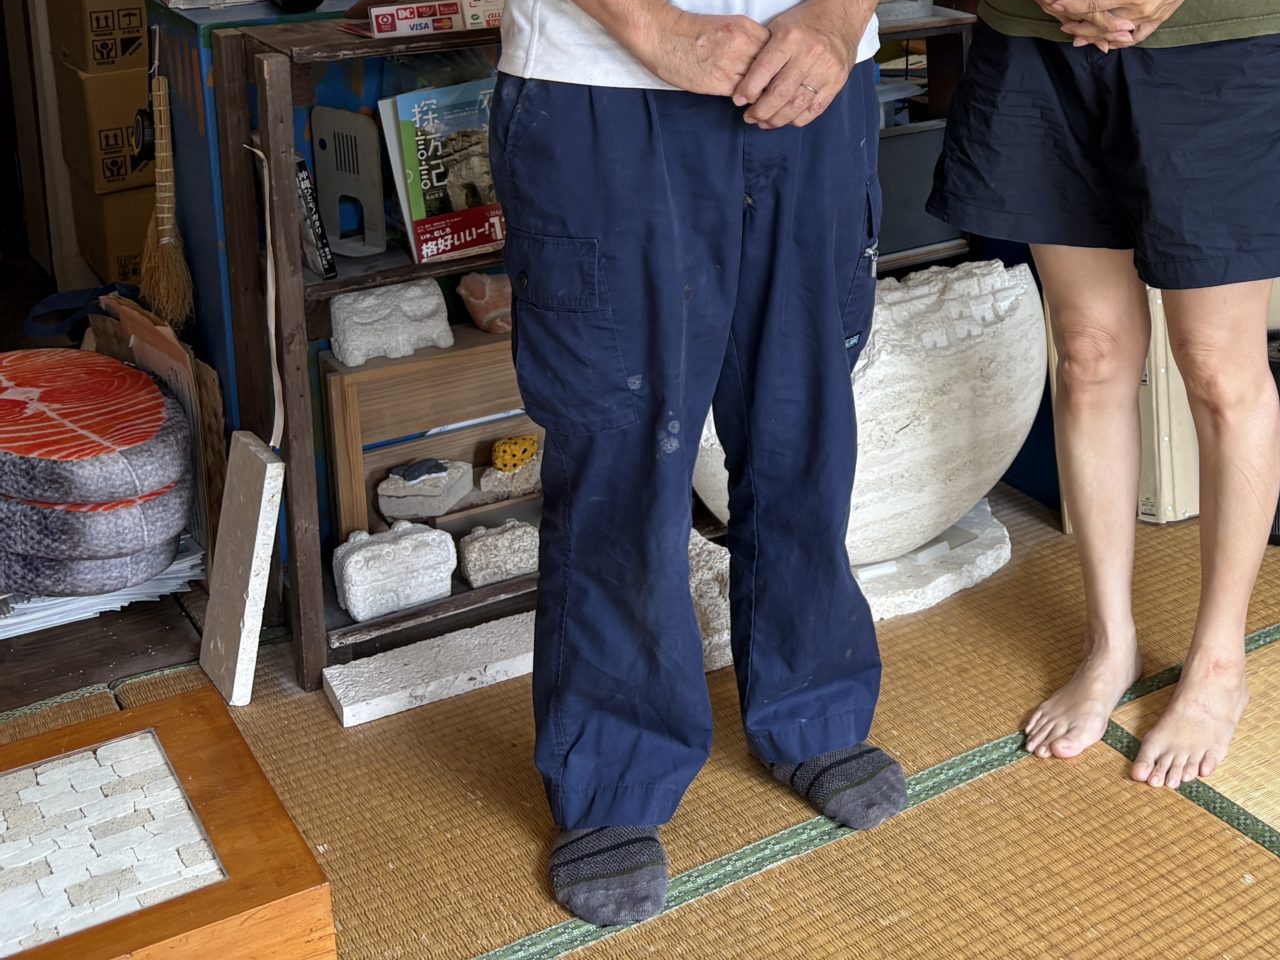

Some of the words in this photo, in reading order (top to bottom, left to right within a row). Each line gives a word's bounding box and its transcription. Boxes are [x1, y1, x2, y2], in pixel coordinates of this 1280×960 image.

[397, 8, 415, 20] DC
[409, 22, 430, 31] VISA
[420, 228, 451, 240] いや、むしろ
